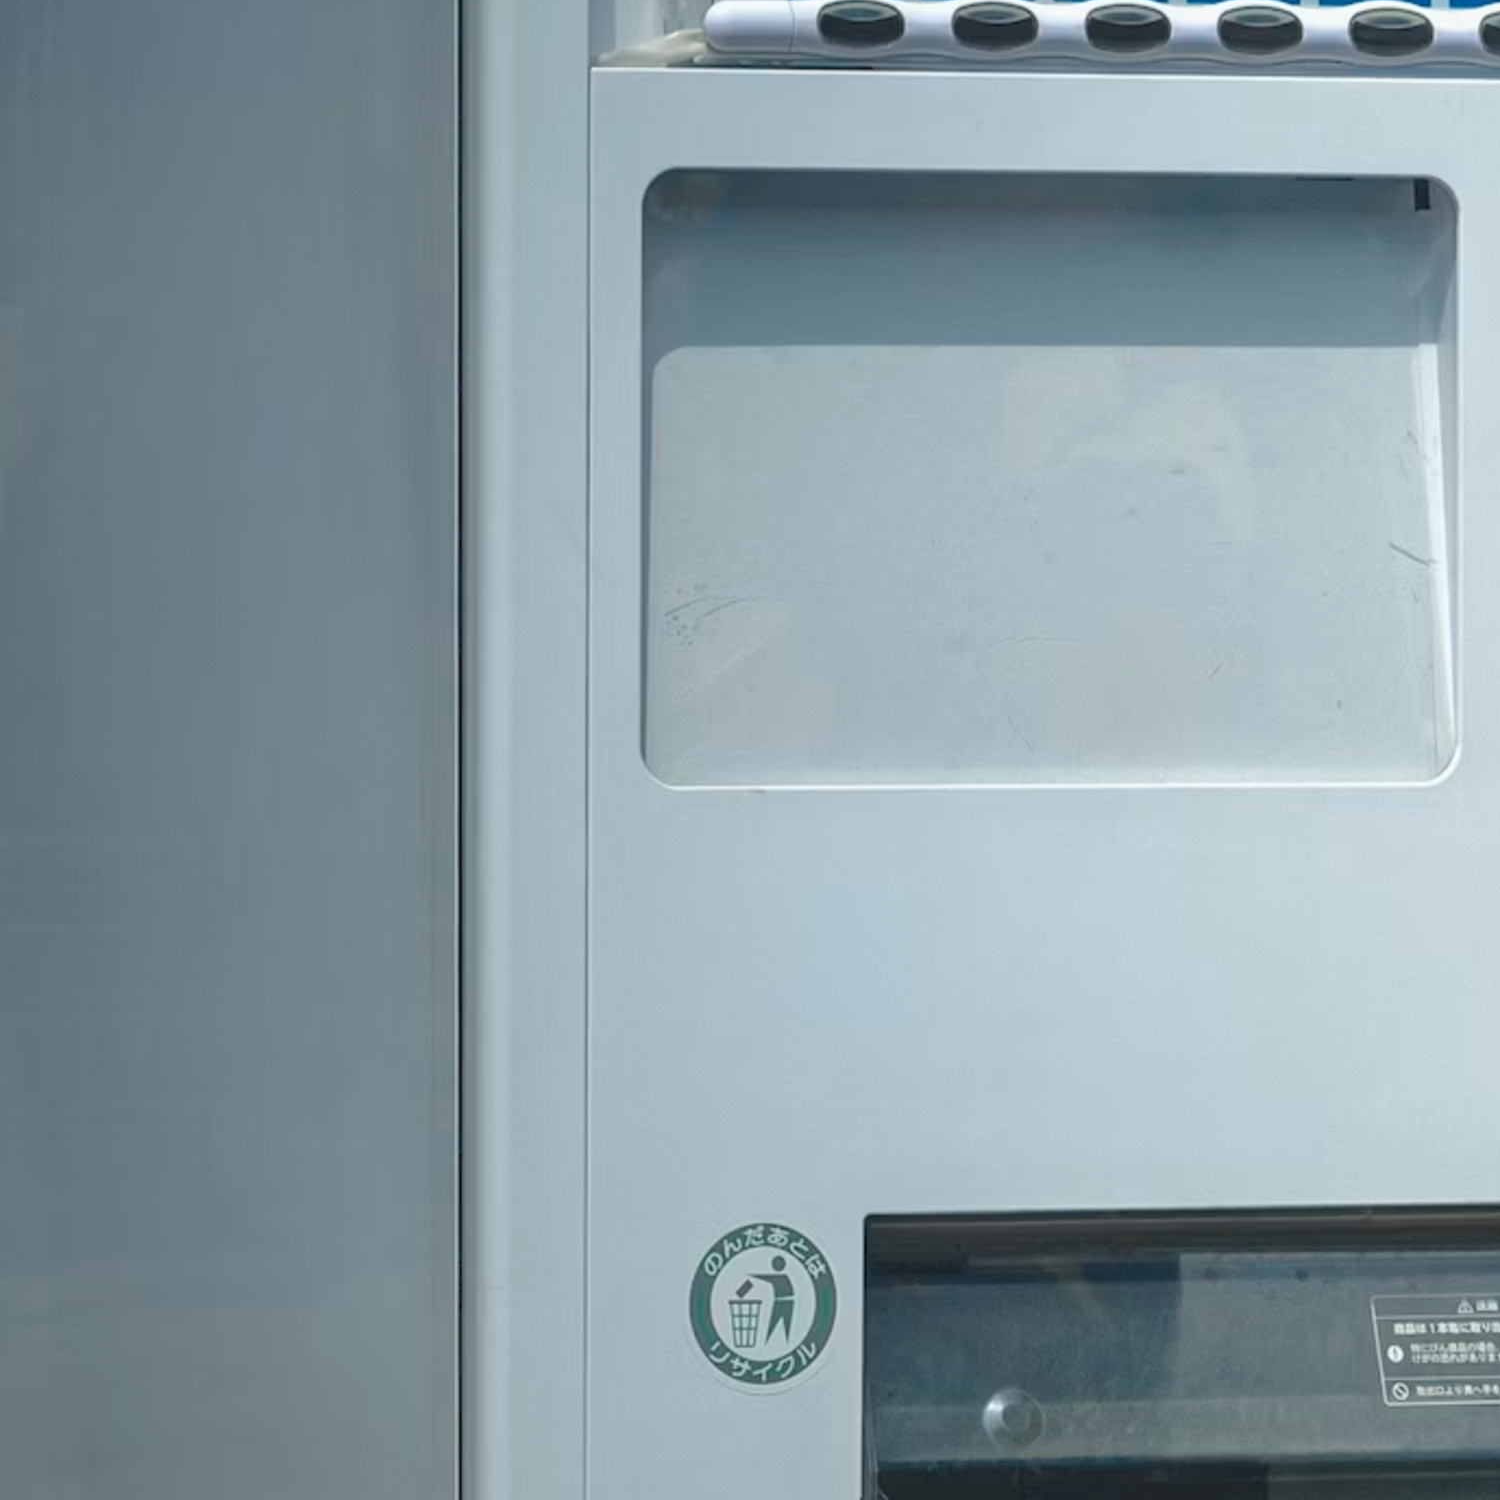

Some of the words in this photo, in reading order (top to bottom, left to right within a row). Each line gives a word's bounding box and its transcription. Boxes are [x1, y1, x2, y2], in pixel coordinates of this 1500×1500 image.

[703, 1225, 827, 1279] のんだあとは
[709, 1341, 817, 1382] リサイクル
